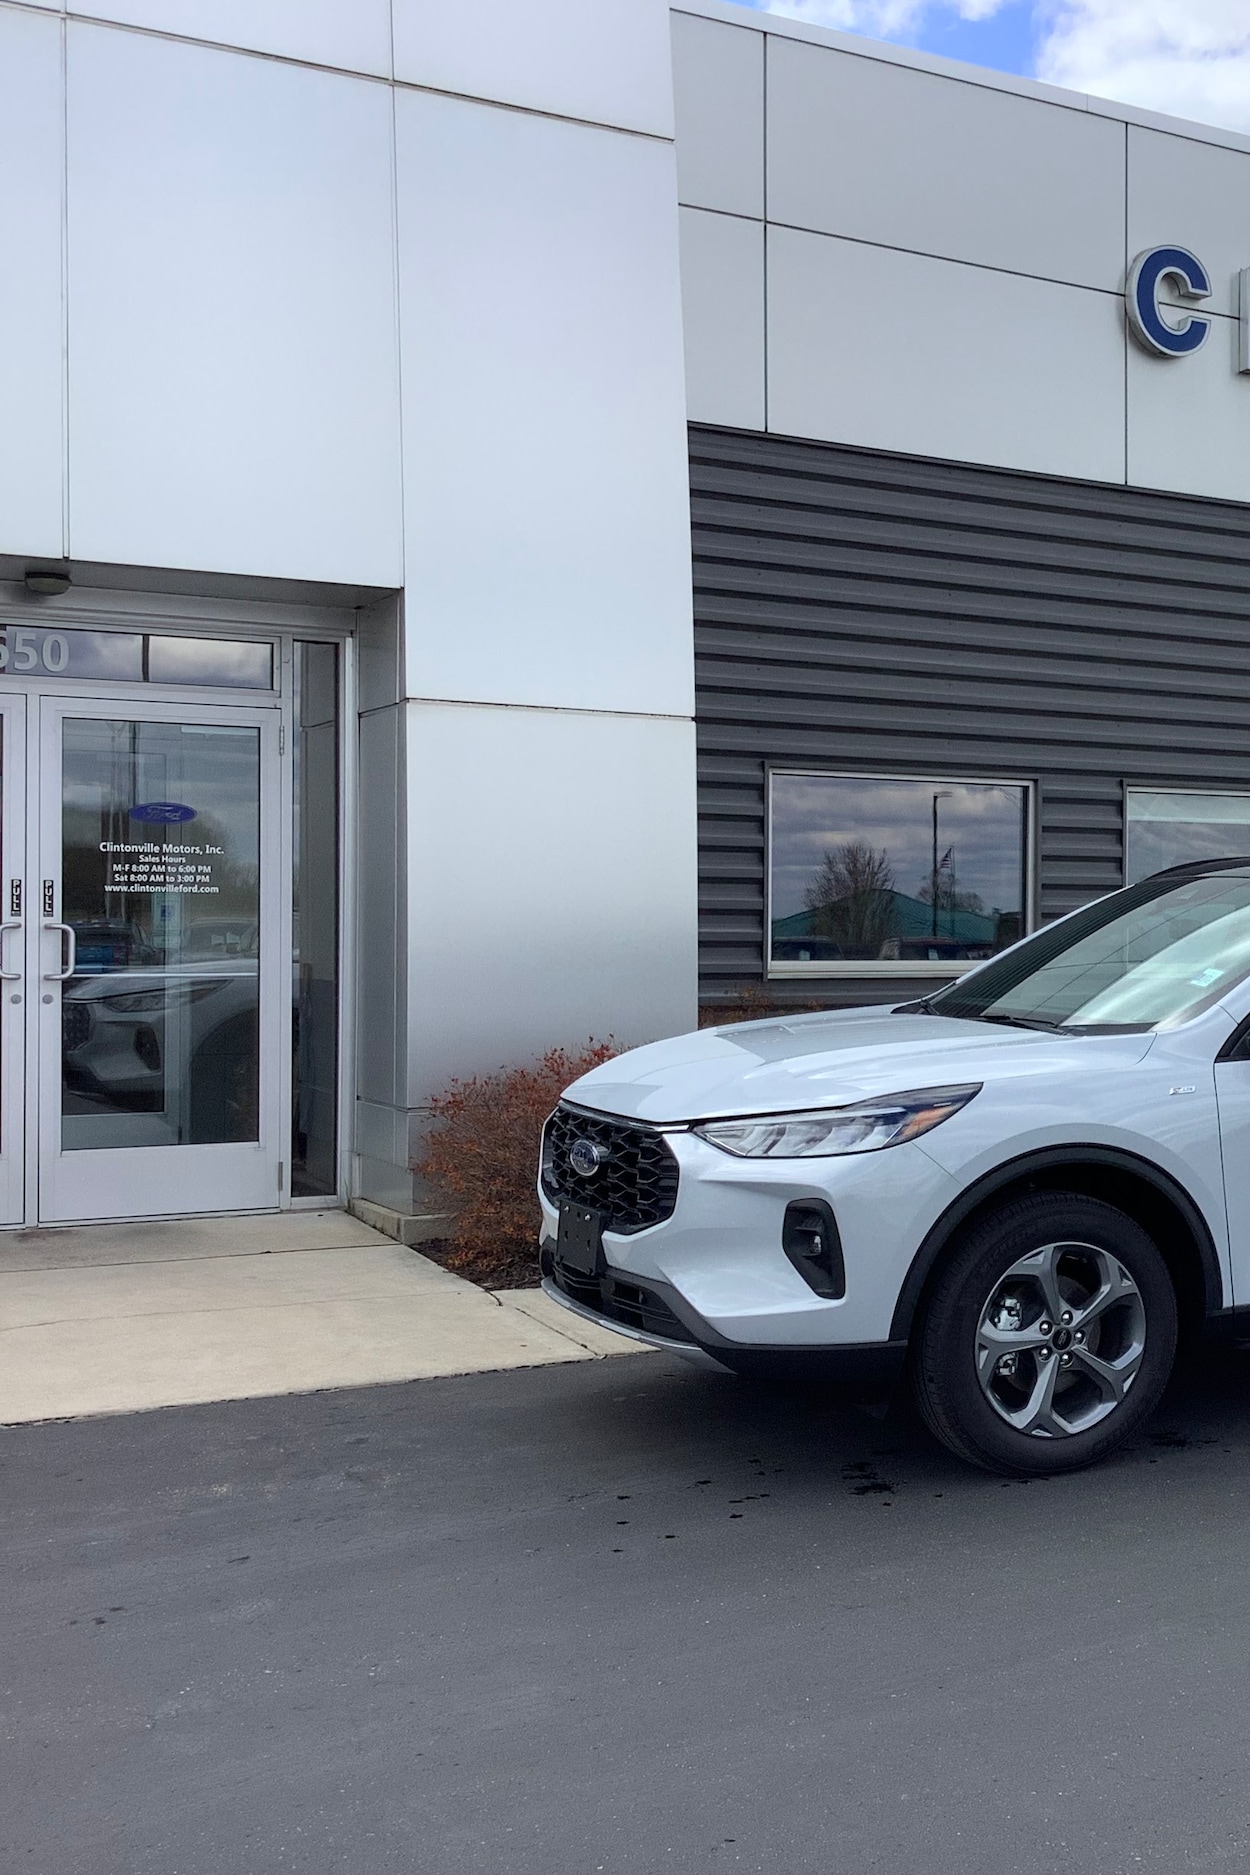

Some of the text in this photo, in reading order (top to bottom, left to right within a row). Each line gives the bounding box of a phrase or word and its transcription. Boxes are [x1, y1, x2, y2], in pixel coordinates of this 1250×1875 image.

[99, 842, 225, 855] Clintonville Motors, Inc.
[139, 855, 160, 863] Sales
[112, 864, 129, 872] M-F
[131, 864, 149, 872] 8:00
[167, 865, 176, 873] to
[178, 865, 196, 873] 6:00
[114, 873, 128, 882] Sat
[130, 874, 147, 882] 8:00
[149, 874, 164, 882] AM
[196, 875, 210, 883] PM
[104, 884, 220, 893] www.clintonvilleford.com
